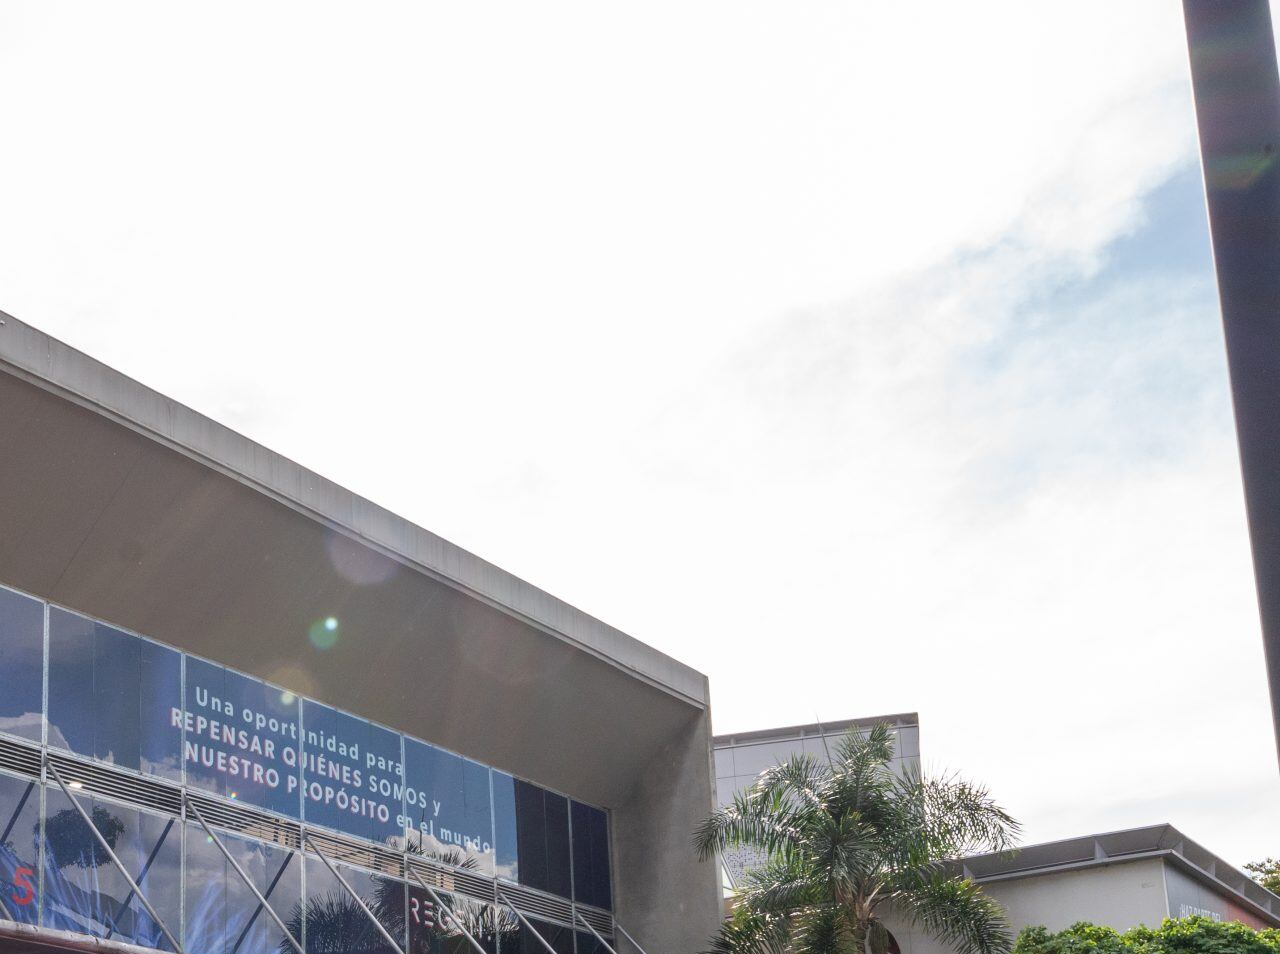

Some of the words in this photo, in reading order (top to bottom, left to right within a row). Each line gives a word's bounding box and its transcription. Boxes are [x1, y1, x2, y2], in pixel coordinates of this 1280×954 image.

[170, 707, 275, 759] REPENSAR
[282, 747, 362, 788] QUIÉNES
[368, 775, 427, 809] SOMOS
[433, 798, 441, 818] y
[195, 686, 234, 717] Una
[366, 751, 403, 777] para
[184, 741, 280, 788] NUESTRO
[287, 774, 390, 823] PROPÓSITO
[396, 813, 414, 831] en
[419, 819, 434, 836] el
[440, 827, 491, 853] mundo
